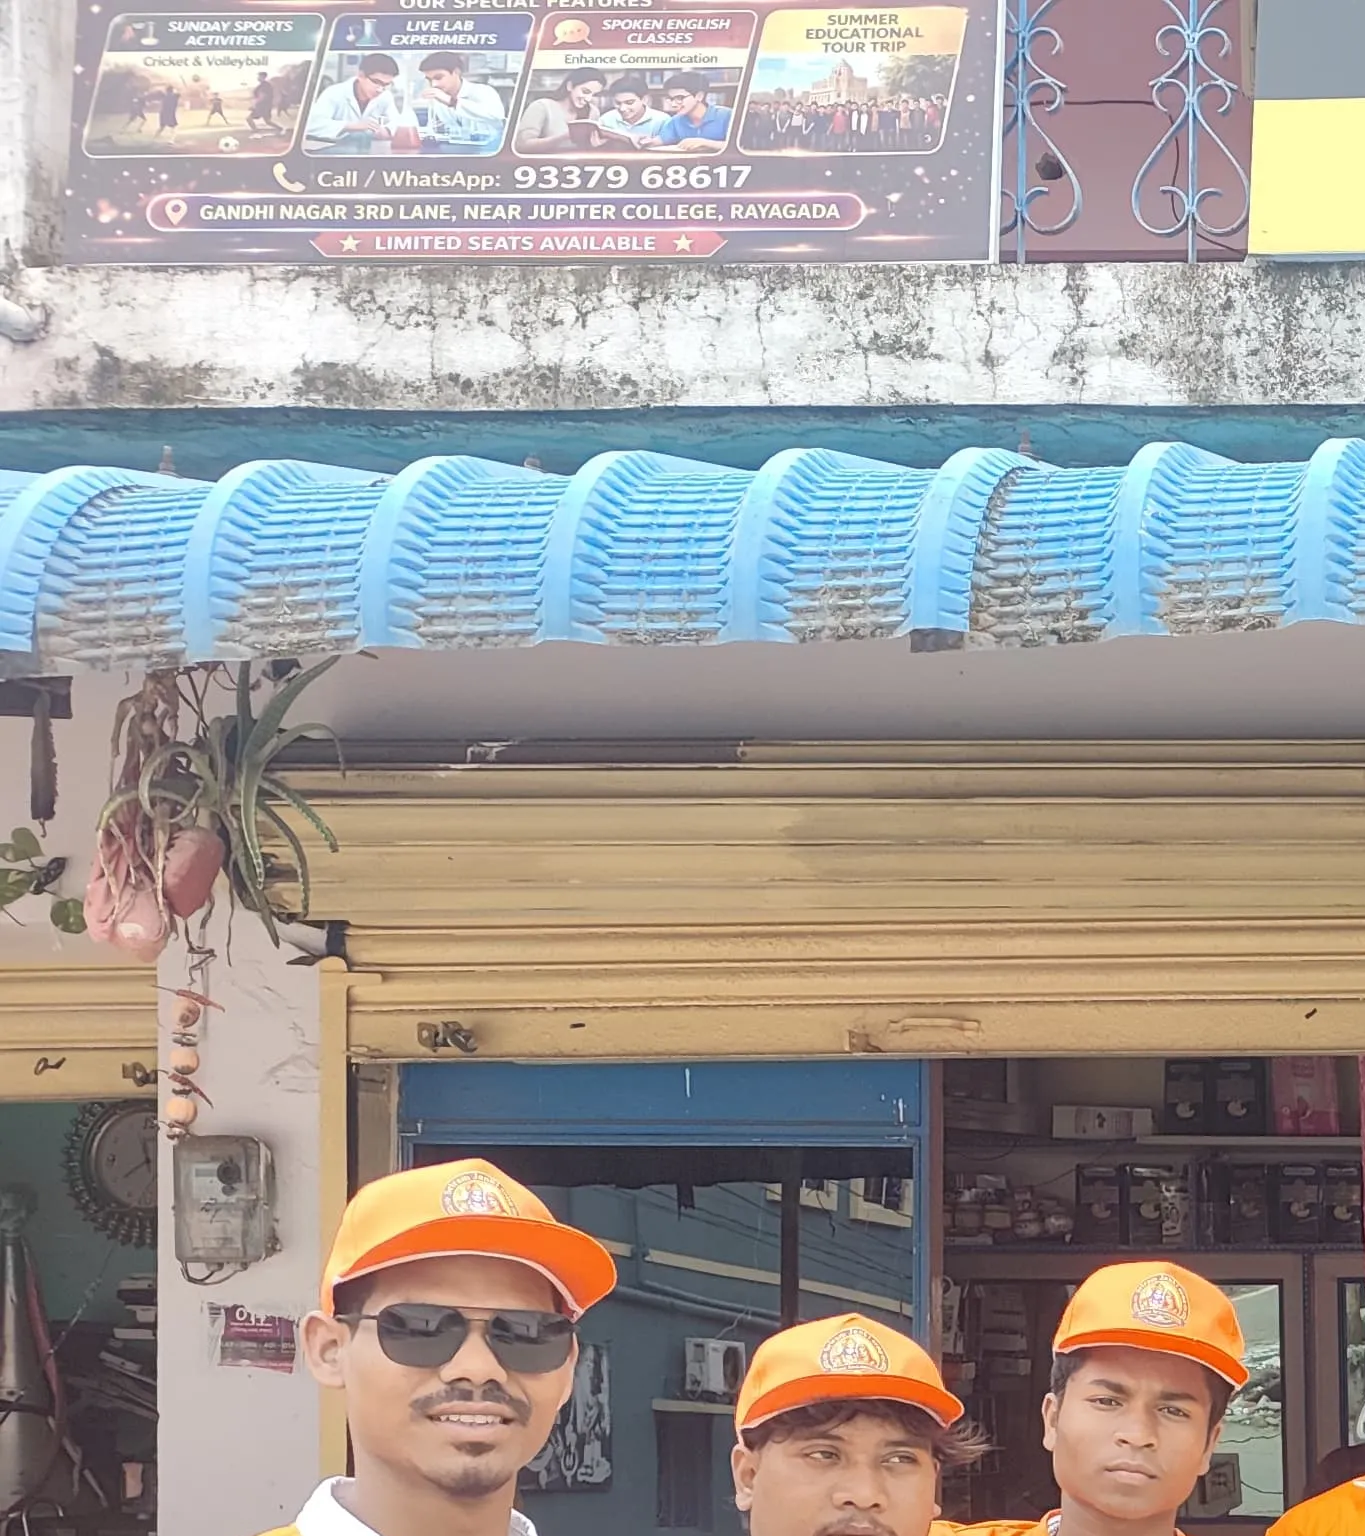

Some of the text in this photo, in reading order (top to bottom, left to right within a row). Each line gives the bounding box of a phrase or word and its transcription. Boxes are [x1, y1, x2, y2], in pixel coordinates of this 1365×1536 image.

[168, 20, 293, 32] SUNDAY SPORTS
[406, 20, 475, 32] LIVE LAB
[602, 17, 731, 31] SPOKEN ENGLISH
[827, 14, 899, 26] SUMMER
[185, 35, 266, 46] ACTIVITIES
[390, 34, 498, 45] EXPERIMENTS
[627, 32, 693, 45] CLASSES
[805, 27, 924, 41] EDUCATIONAL
[822, 40, 907, 54] TOUR TRIP
[143, 55, 269, 69] Cricket & Volleyball
[565, 52, 718, 65] Enhance Communication
[317, 165, 752, 193] Call / WhatsApp: 93379 68617
[200, 202, 841, 223] GANDHI NAGAR 3RD LANE, NEAR JUPITER COLLEGE, RAYAGADA
[375, 235, 656, 251] LIMITED SEATS AVAILABLE
